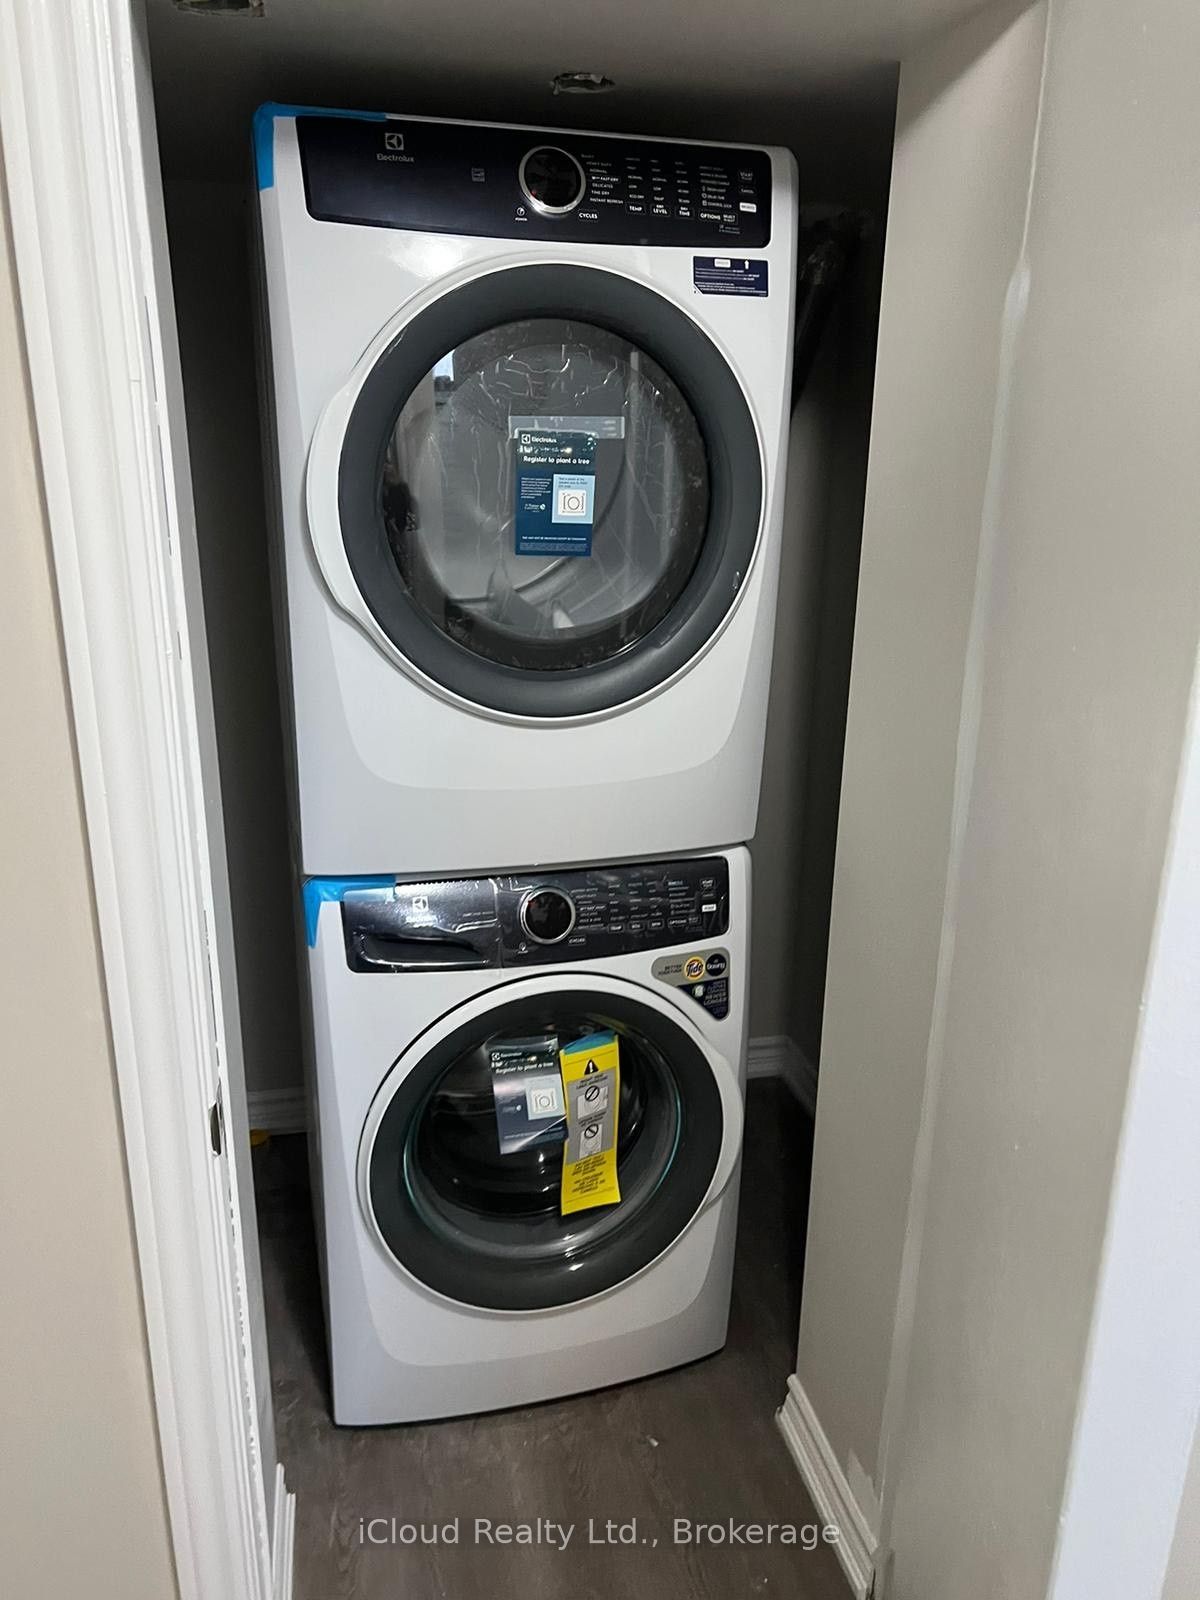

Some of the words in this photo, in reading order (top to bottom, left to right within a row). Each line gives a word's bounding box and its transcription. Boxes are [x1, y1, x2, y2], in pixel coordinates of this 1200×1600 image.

[376, 152, 415, 162] Electrolux
[579, 211, 598, 219] CYCLES
[531, 436, 557, 444] Electrolux
[523, 455, 548, 465] Register
[556, 457, 571, 465] plant
[578, 457, 590, 465] tree
[495, 1065, 517, 1074] Register
[524, 1063, 539, 1071] plant
